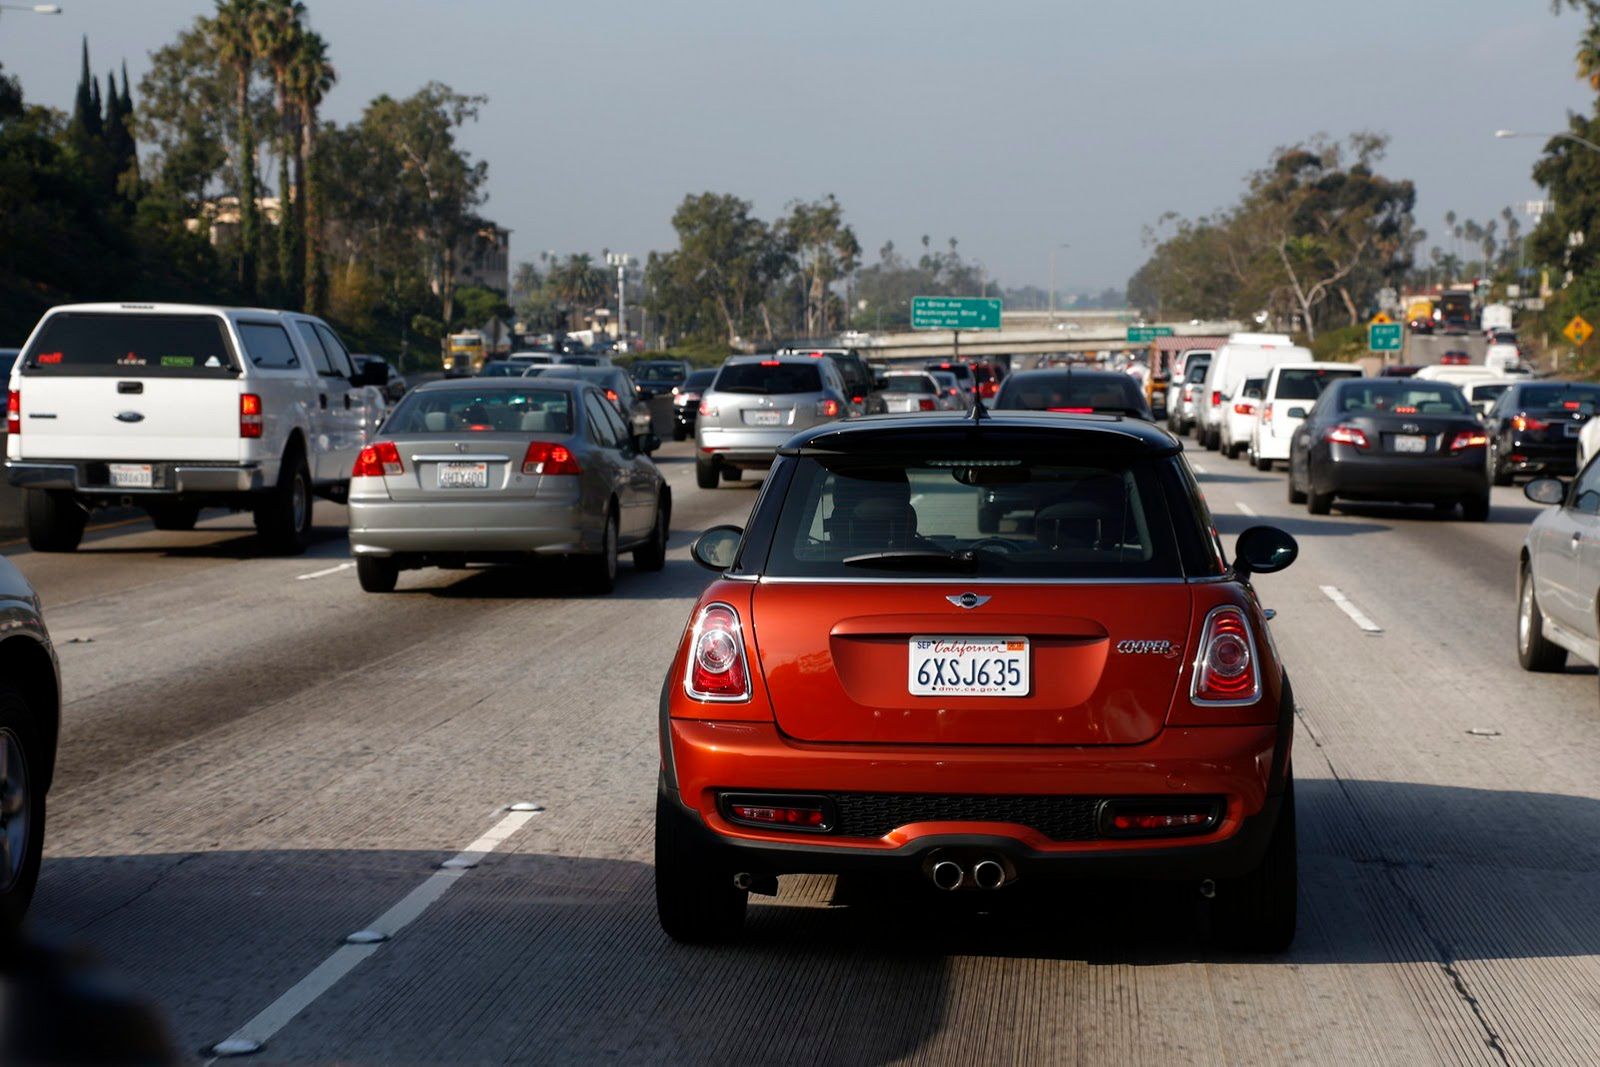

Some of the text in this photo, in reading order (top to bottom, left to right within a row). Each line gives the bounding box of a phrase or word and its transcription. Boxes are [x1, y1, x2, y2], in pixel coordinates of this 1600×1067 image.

[917, 641, 931, 649] SEP
[934, 640, 1006, 657] California
[1116, 639, 1181, 659] COOPER S
[917, 658, 1021, 686] 6XSJ635
